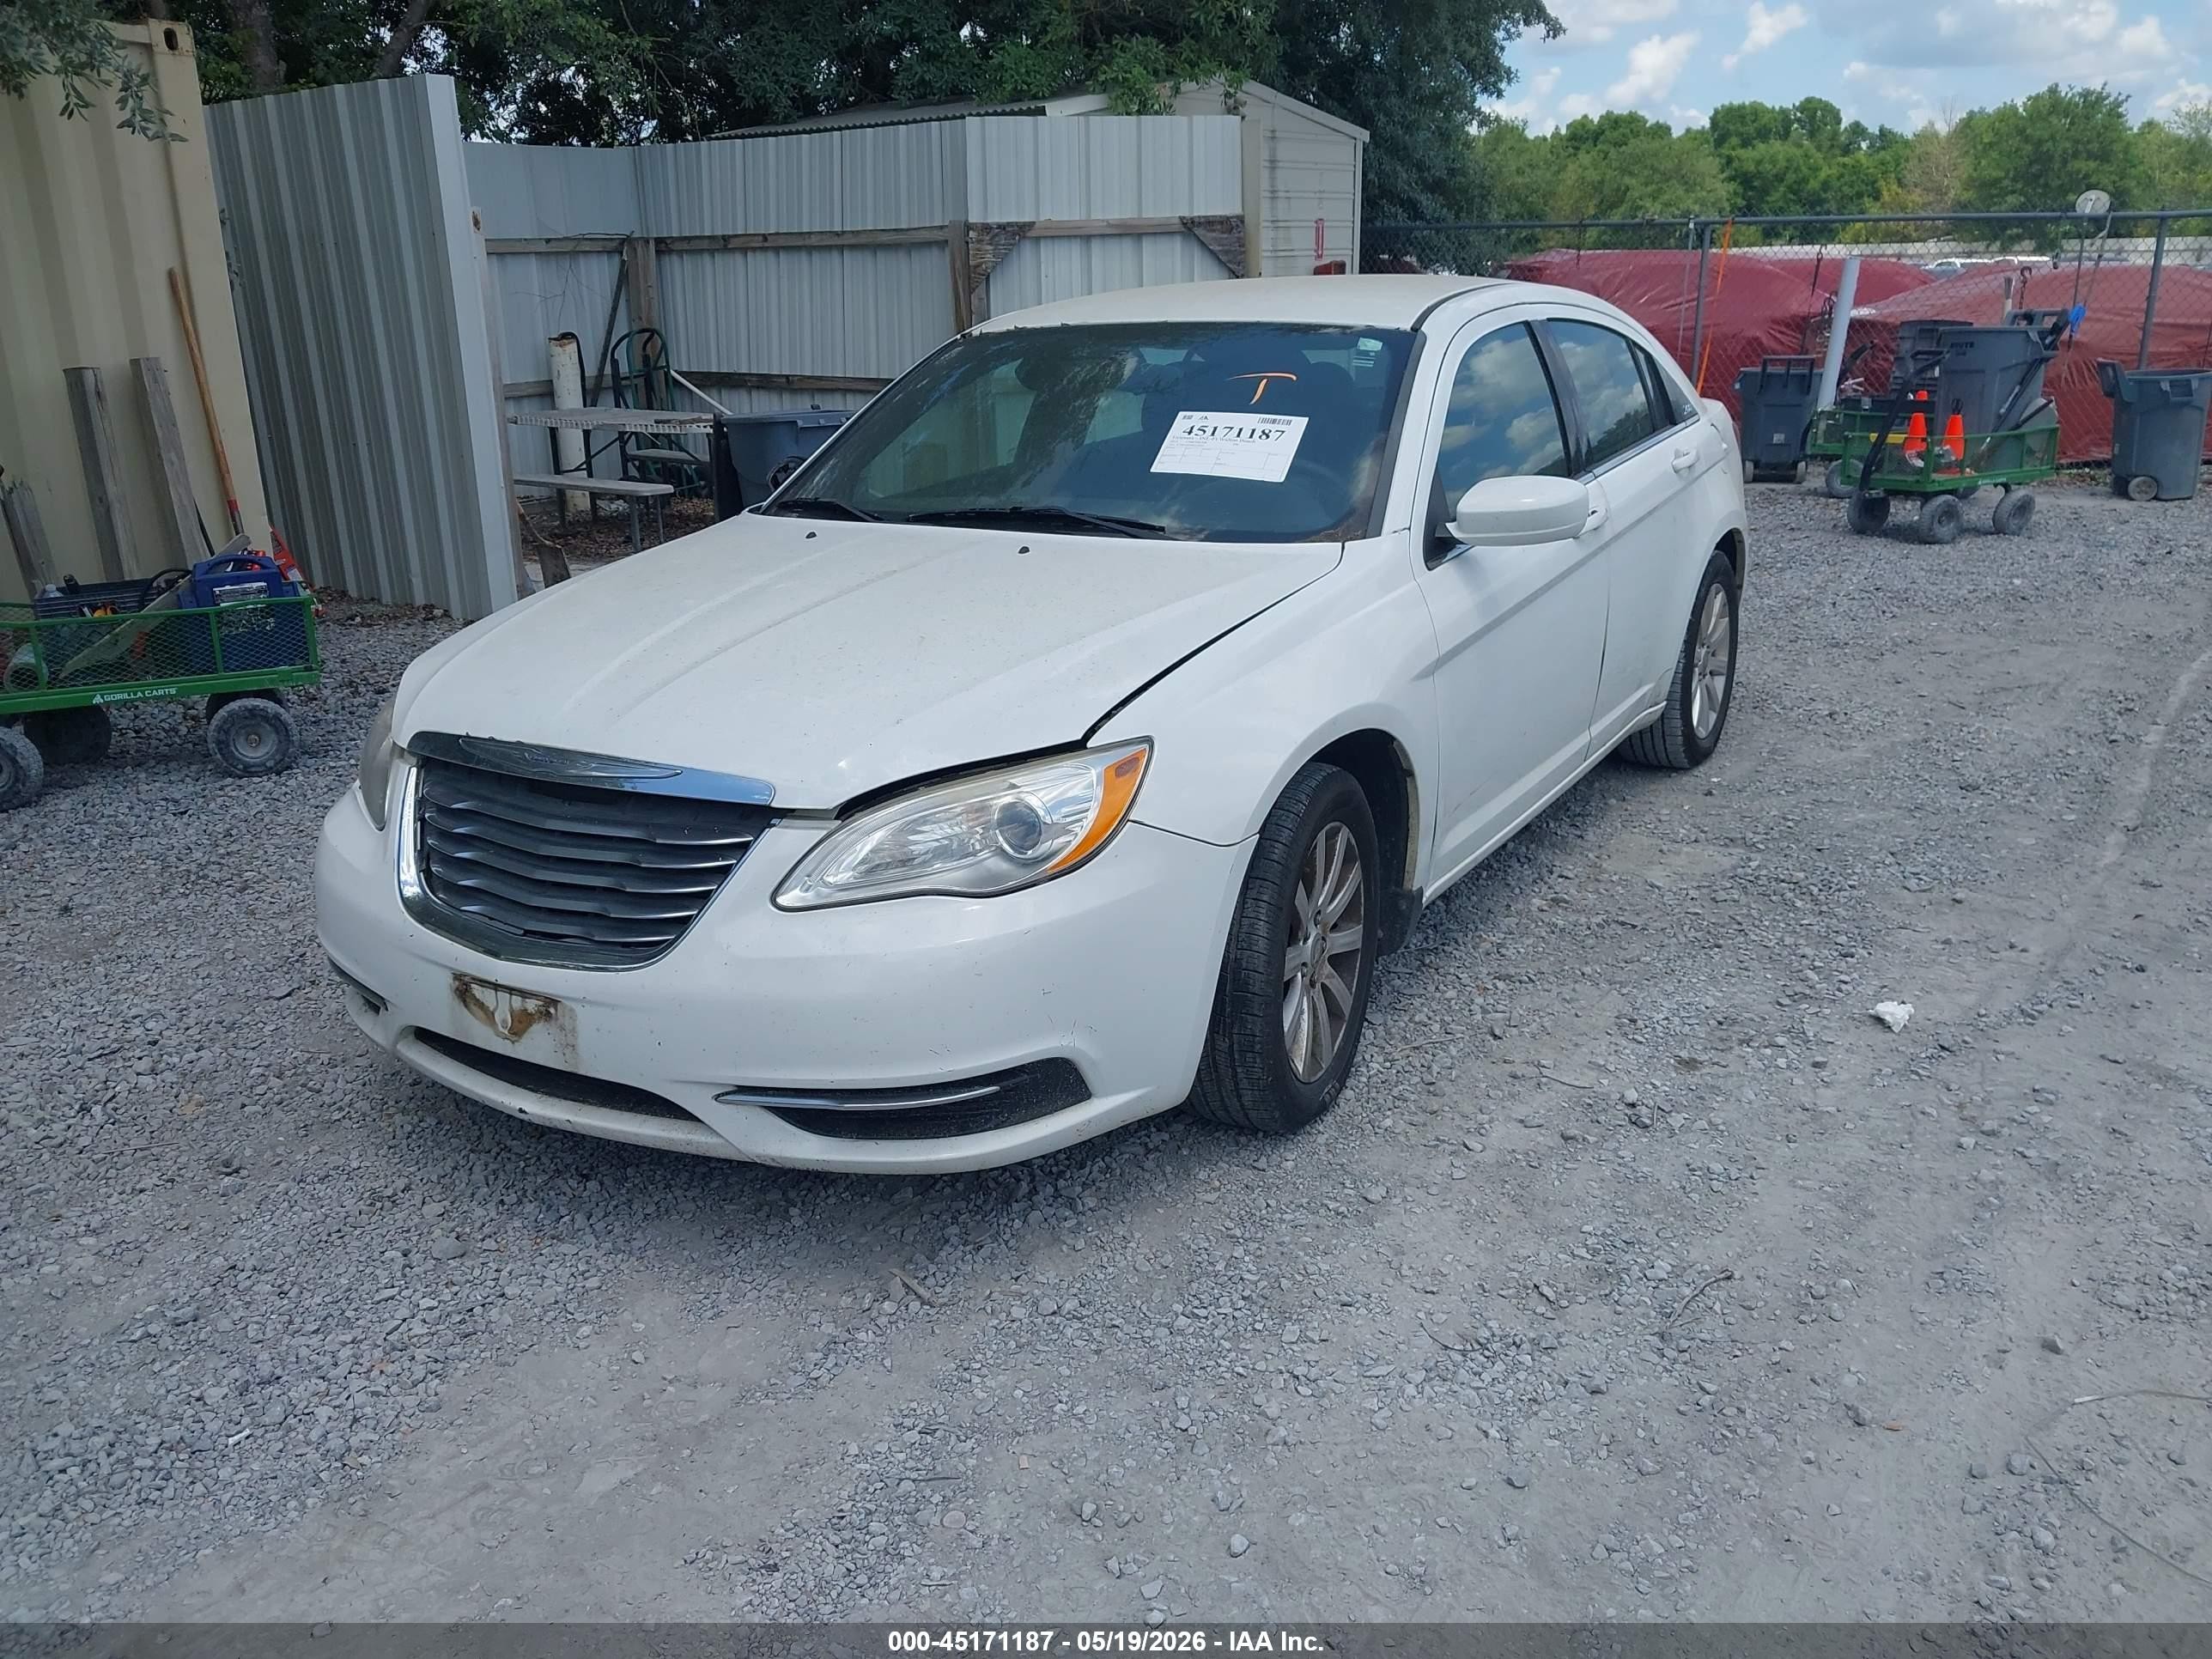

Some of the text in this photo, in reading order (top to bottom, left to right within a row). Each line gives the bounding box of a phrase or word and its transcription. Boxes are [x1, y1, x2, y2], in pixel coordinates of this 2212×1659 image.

[1182, 424, 1286, 441] 45171187
[104, 688, 177, 702] GORILLA CARTS
